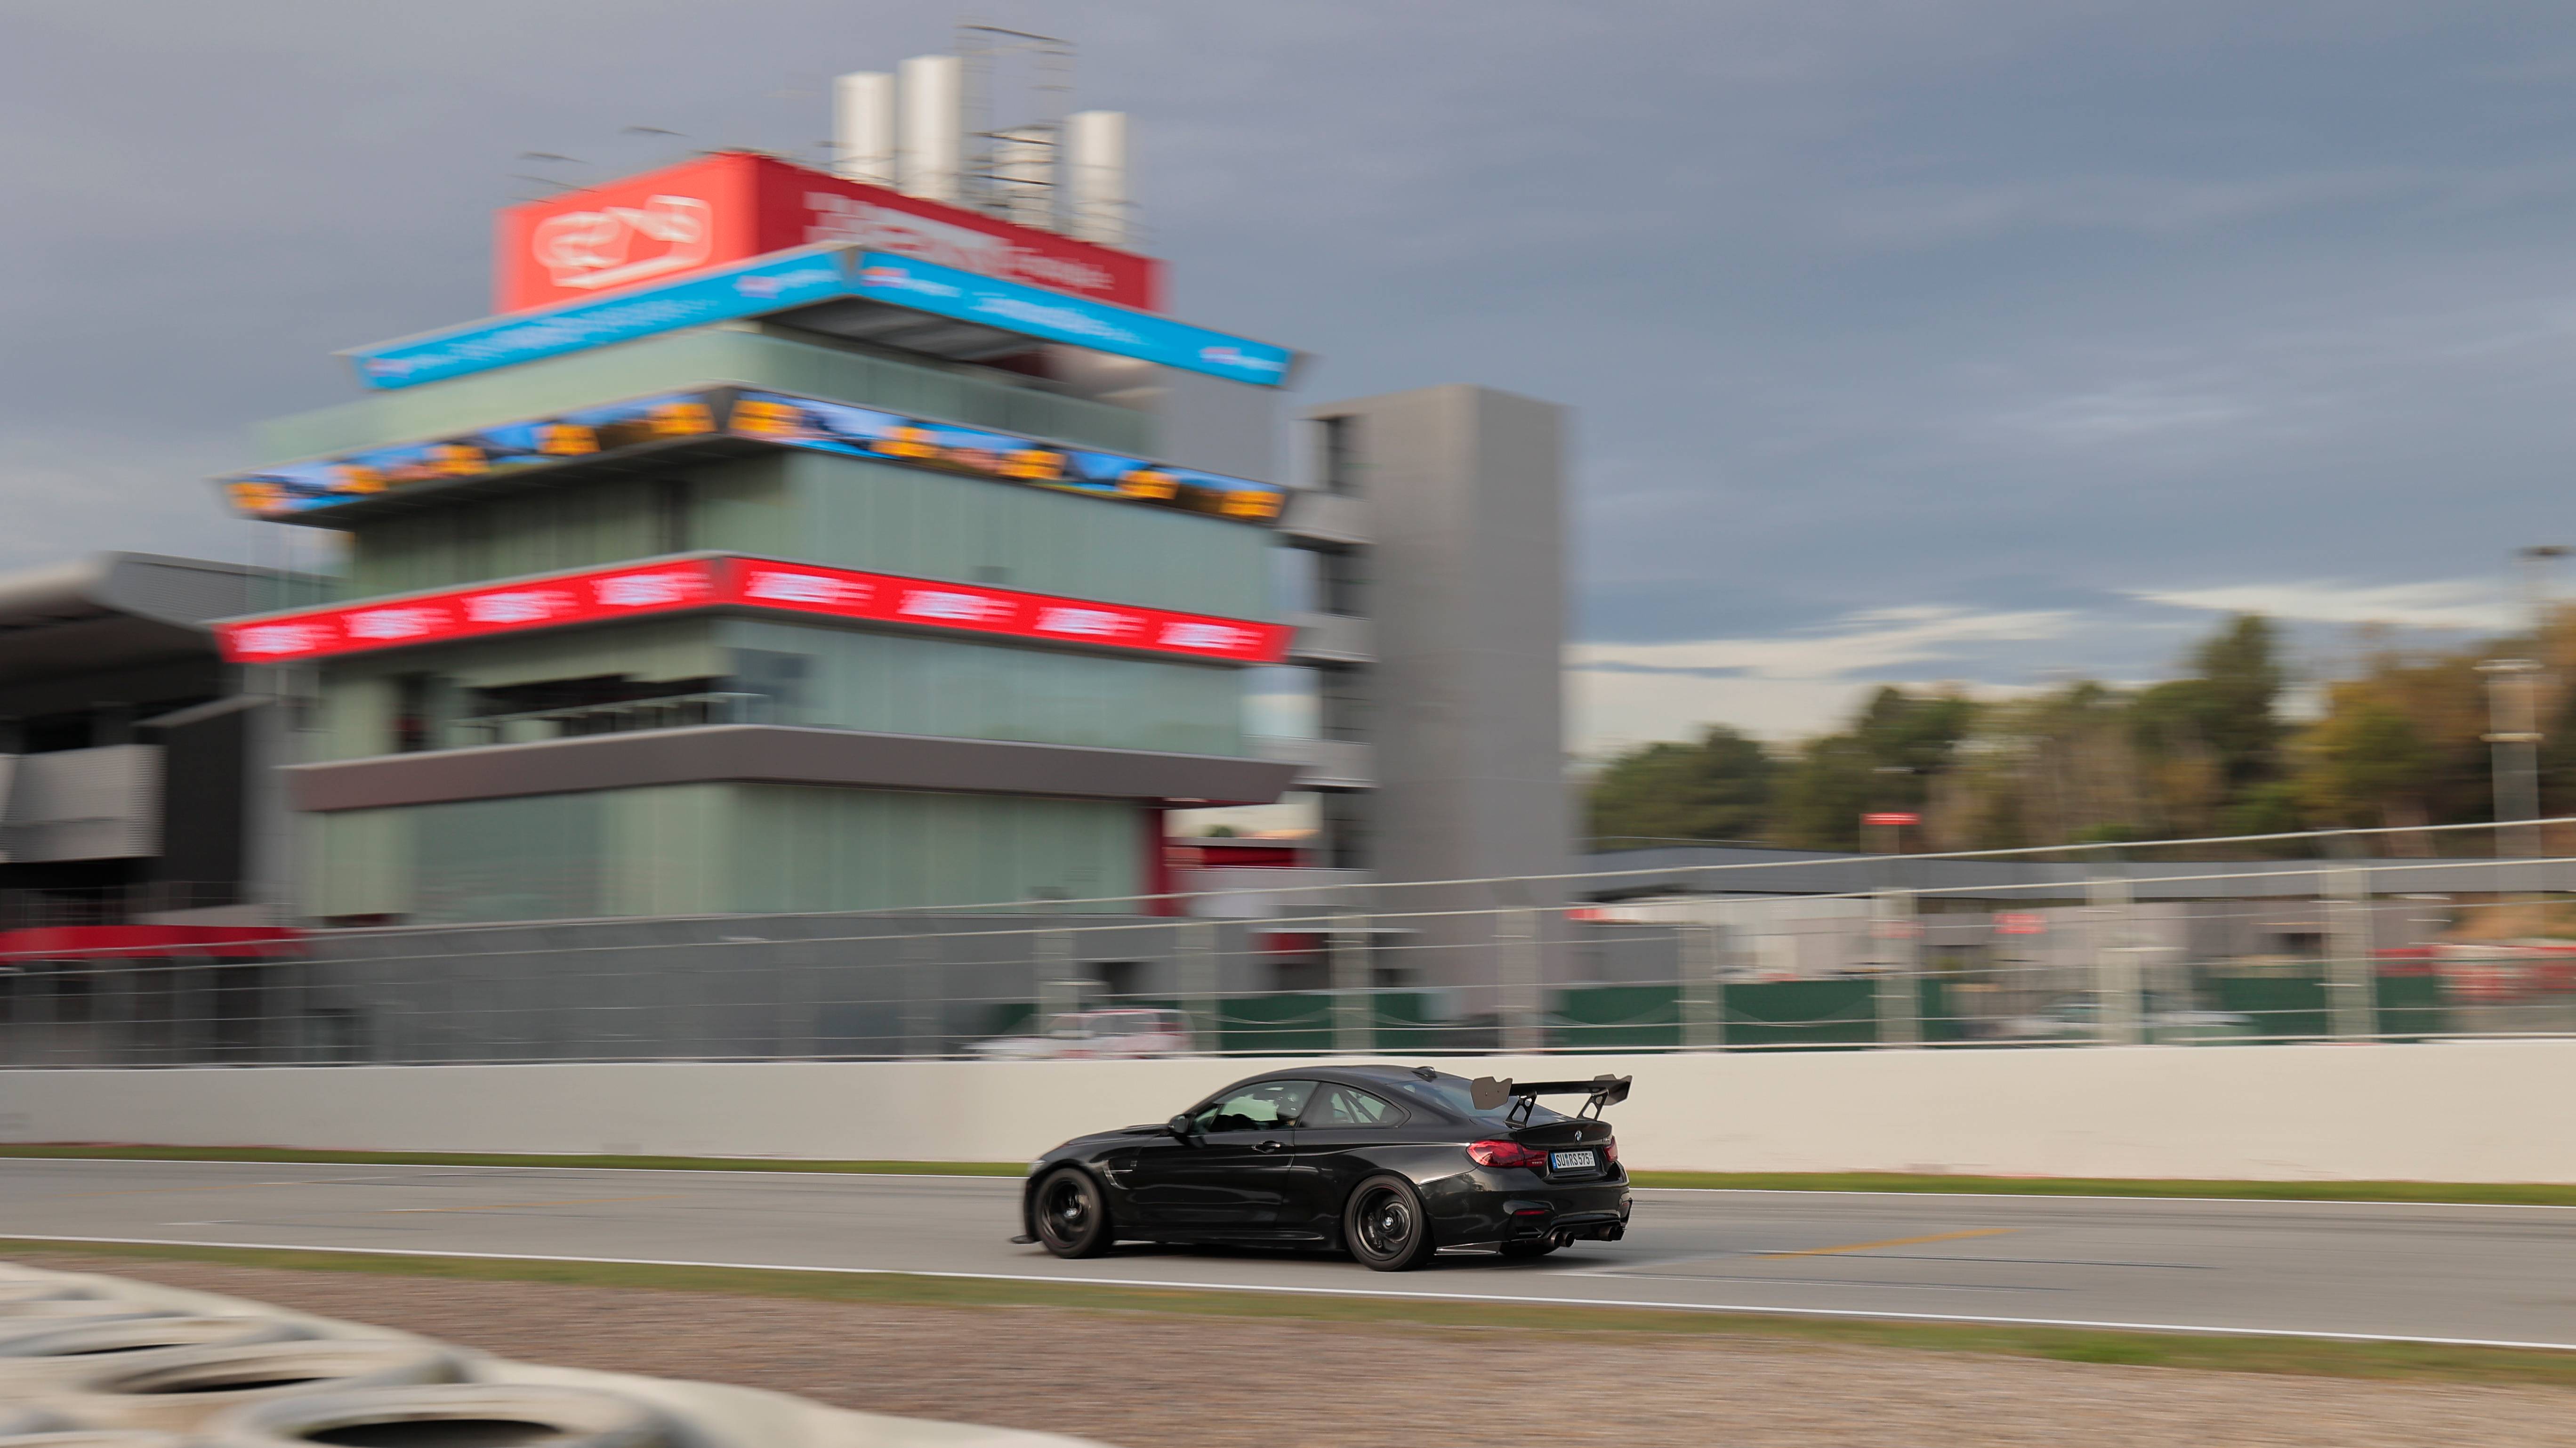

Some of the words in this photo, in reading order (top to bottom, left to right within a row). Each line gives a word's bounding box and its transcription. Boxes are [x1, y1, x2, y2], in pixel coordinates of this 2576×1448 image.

[1556, 1154, 1566, 1166] SU
[1569, 1153, 1578, 1165] RS
[1578, 1153, 1590, 1165] 575
